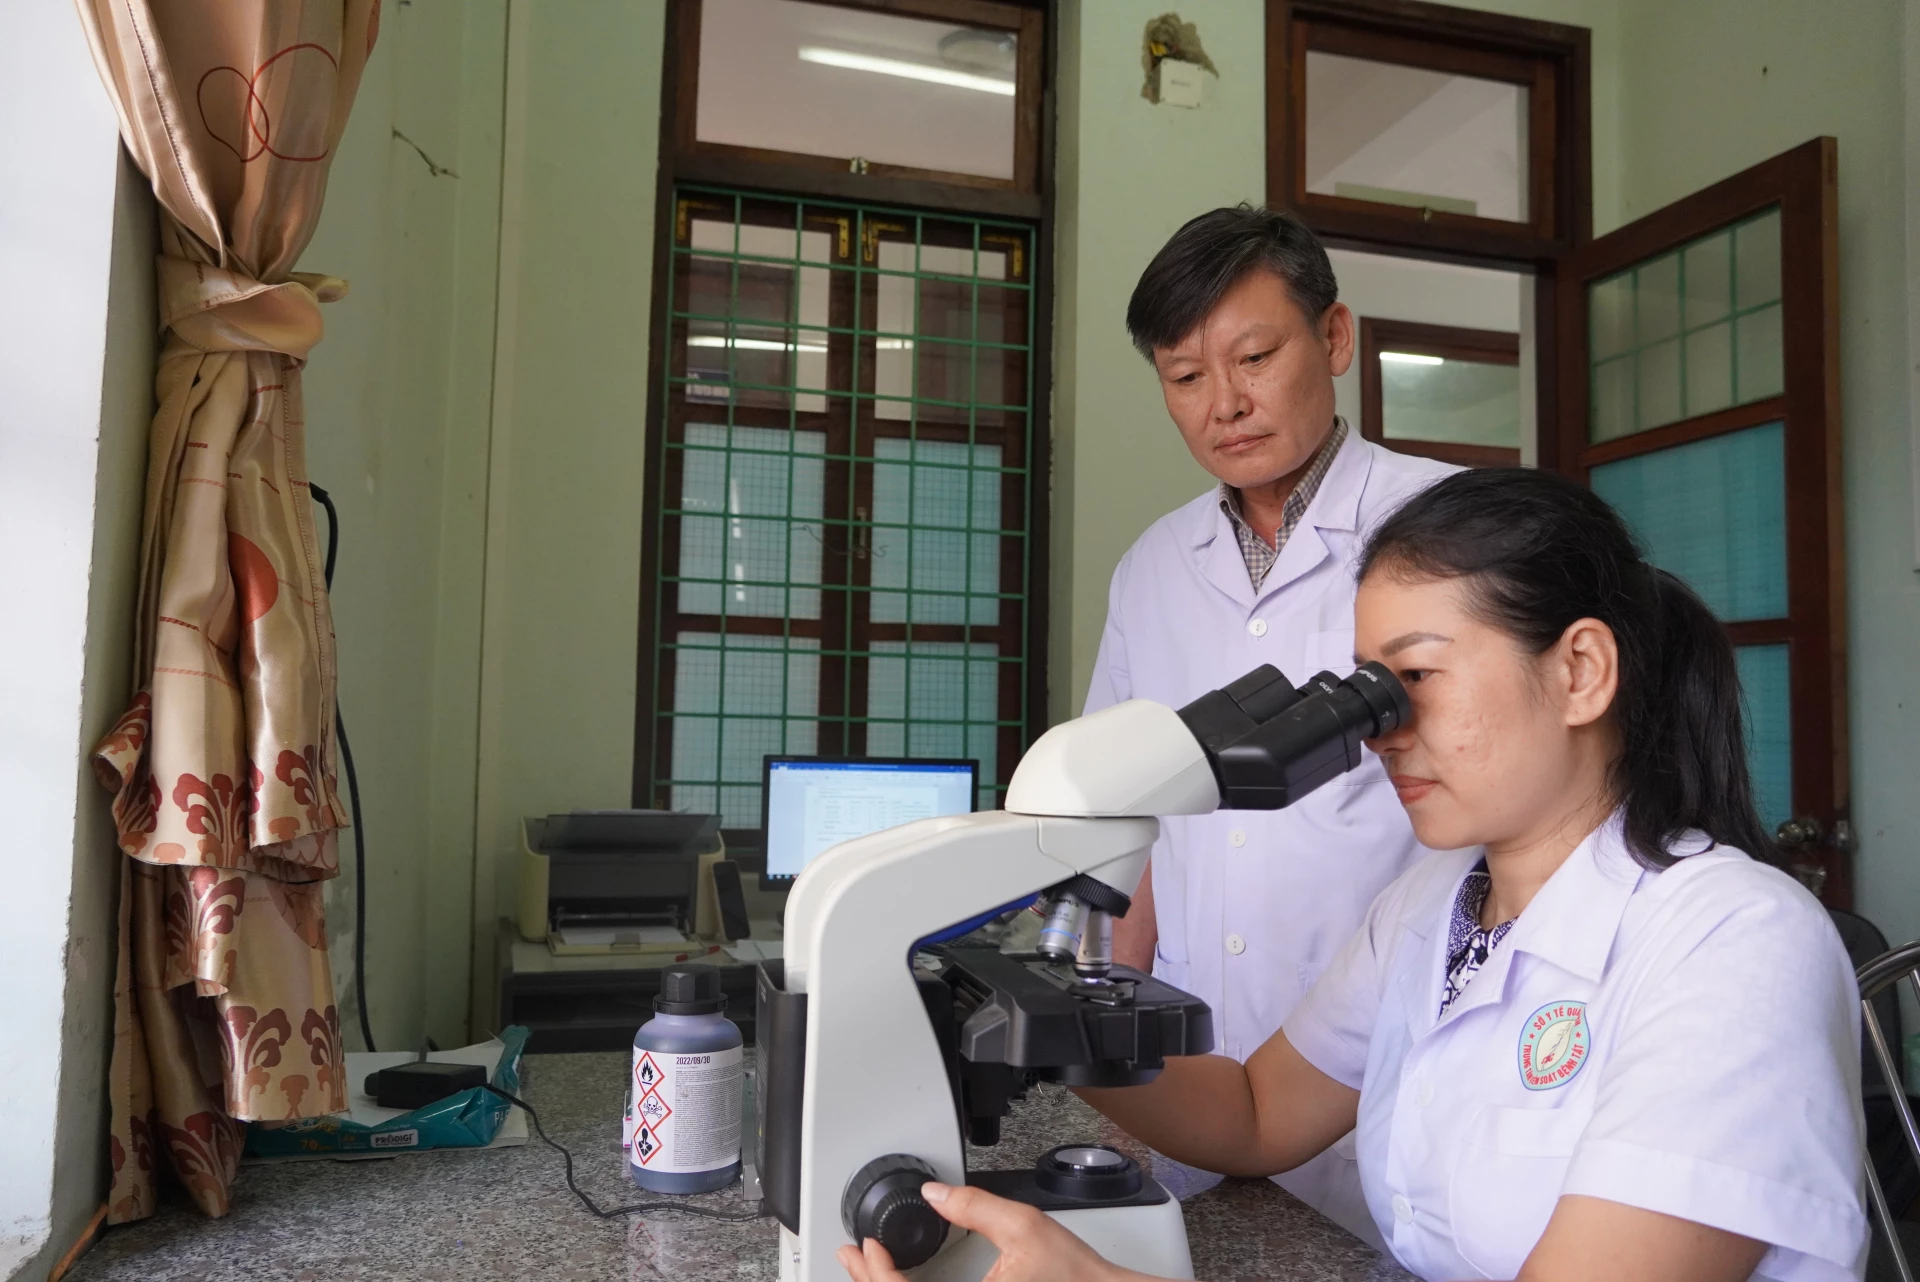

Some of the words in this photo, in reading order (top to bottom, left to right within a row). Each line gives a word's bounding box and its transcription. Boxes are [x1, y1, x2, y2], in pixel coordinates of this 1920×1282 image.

[1545, 1012, 1552, 1021] Y
[1553, 1005, 1564, 1018] TẾ
[676, 1055, 711, 1065] 2022/09/30
[1523, 1044, 1531, 1069] TRUNG
[1540, 1072, 1558, 1085] SOÁT
[1556, 1058, 1578, 1078] BỆNH
[1571, 1044, 1585, 1059] TẬT
